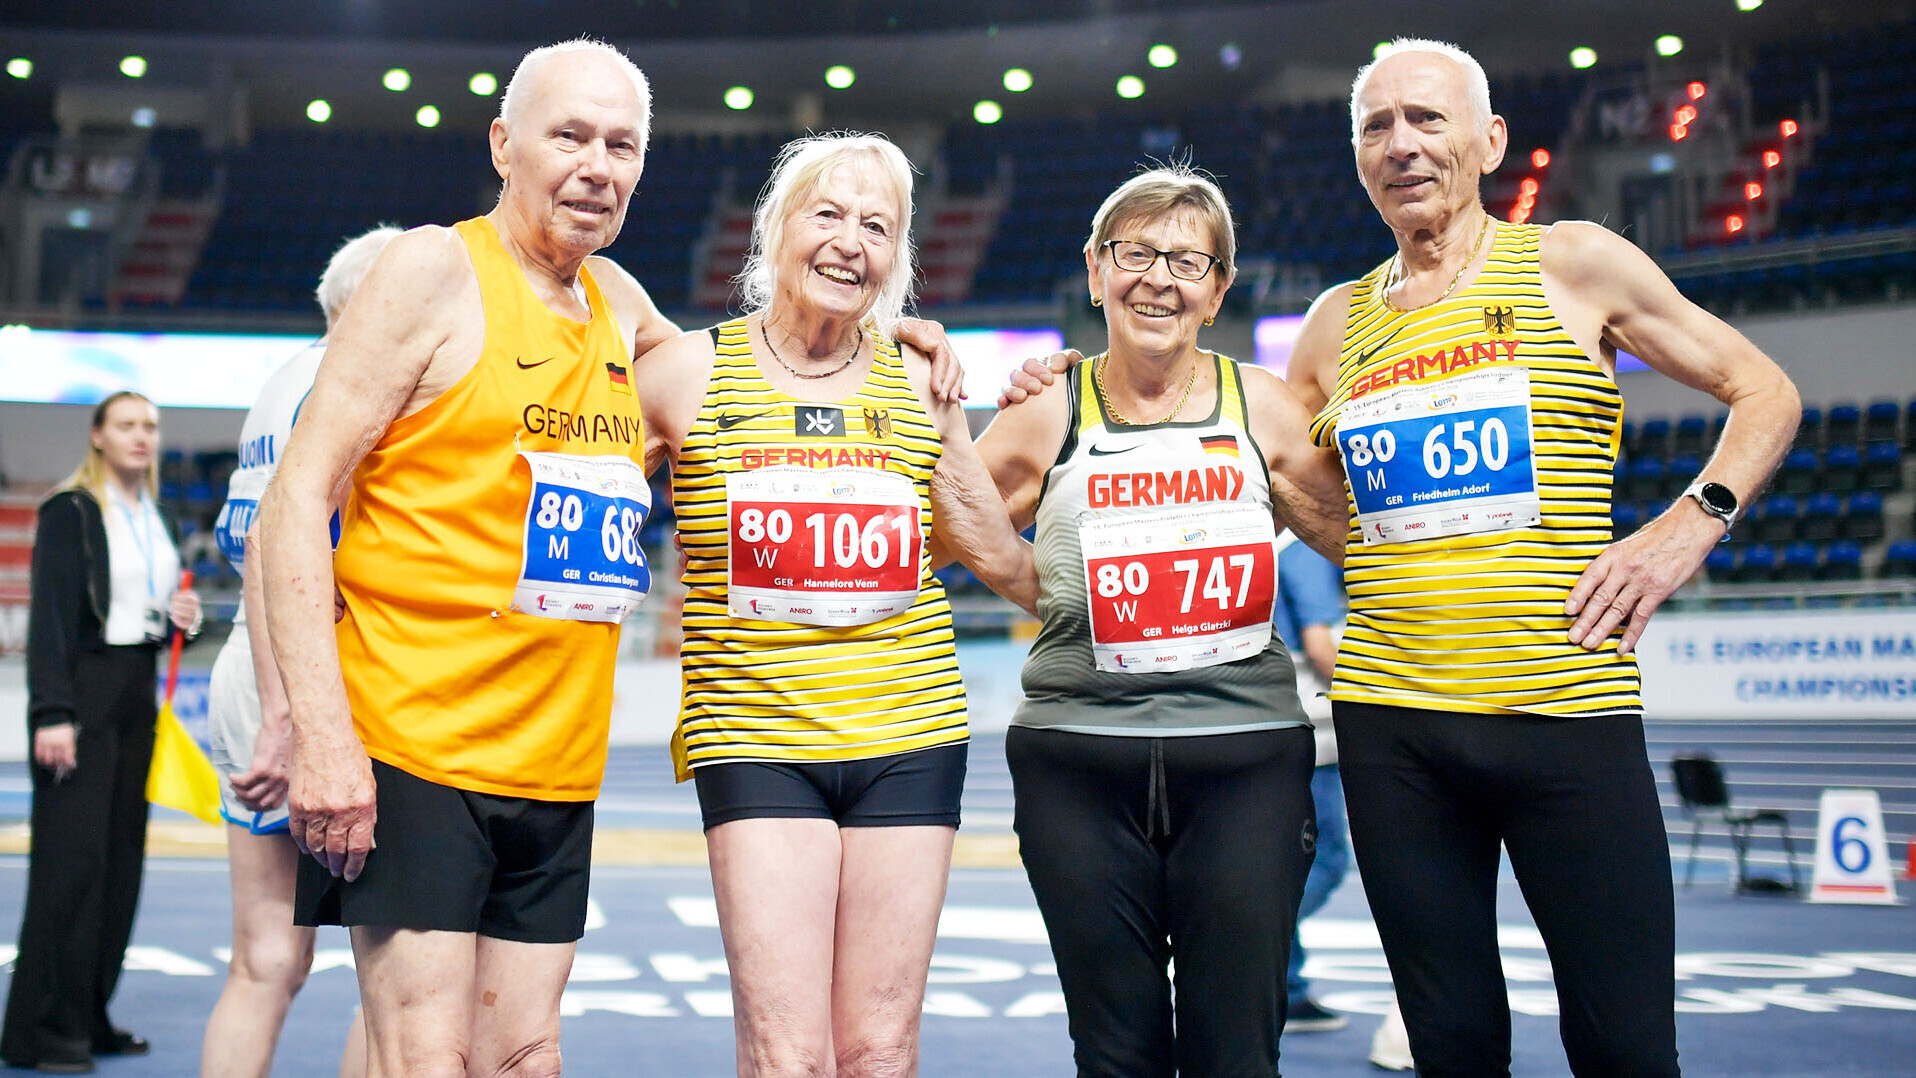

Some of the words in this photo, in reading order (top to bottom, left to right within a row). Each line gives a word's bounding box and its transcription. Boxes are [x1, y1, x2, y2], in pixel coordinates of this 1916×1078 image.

[1350, 339, 1522, 401] GERMANY
[523, 403, 640, 446] GERMANY
[741, 448, 892, 470] GERMANY
[1348, 429, 1396, 467] 80
[1423, 417, 1509, 479] 650
[1087, 465, 1245, 509] GERMANY
[1366, 468, 1387, 492] M
[1385, 495, 1404, 506] GER
[1412, 486, 1461, 502] Friedhelm
[1462, 482, 1491, 496] Adorf
[536, 491, 583, 531] 80
[1404, 521, 1426, 531] ANIRO
[548, 534, 569, 560] M
[738, 508, 793, 544] 80
[805, 512, 911, 569] 1061
[753, 547, 779, 569] W
[562, 569, 581, 580] GER
[588, 571, 622, 584] Christian
[774, 577, 794, 587] GER
[803, 578, 853, 588] Hannelore
[854, 579, 879, 588] Venn
[1096, 561, 1150, 598] 80
[1173, 553, 1255, 614] 747
[573, 602, 595, 611] ANIRO
[789, 607, 813, 616] ANIRO
[1112, 600, 1138, 623] W
[1142, 627, 1163, 638] GER
[1171, 624, 1199, 636] Helga
[1200, 619, 1232, 632] Glatzki
[1155, 655, 1178, 664] ANIRO
[1713, 636, 1863, 664] EUROPEAN
[1832, 817, 1871, 873] 6
